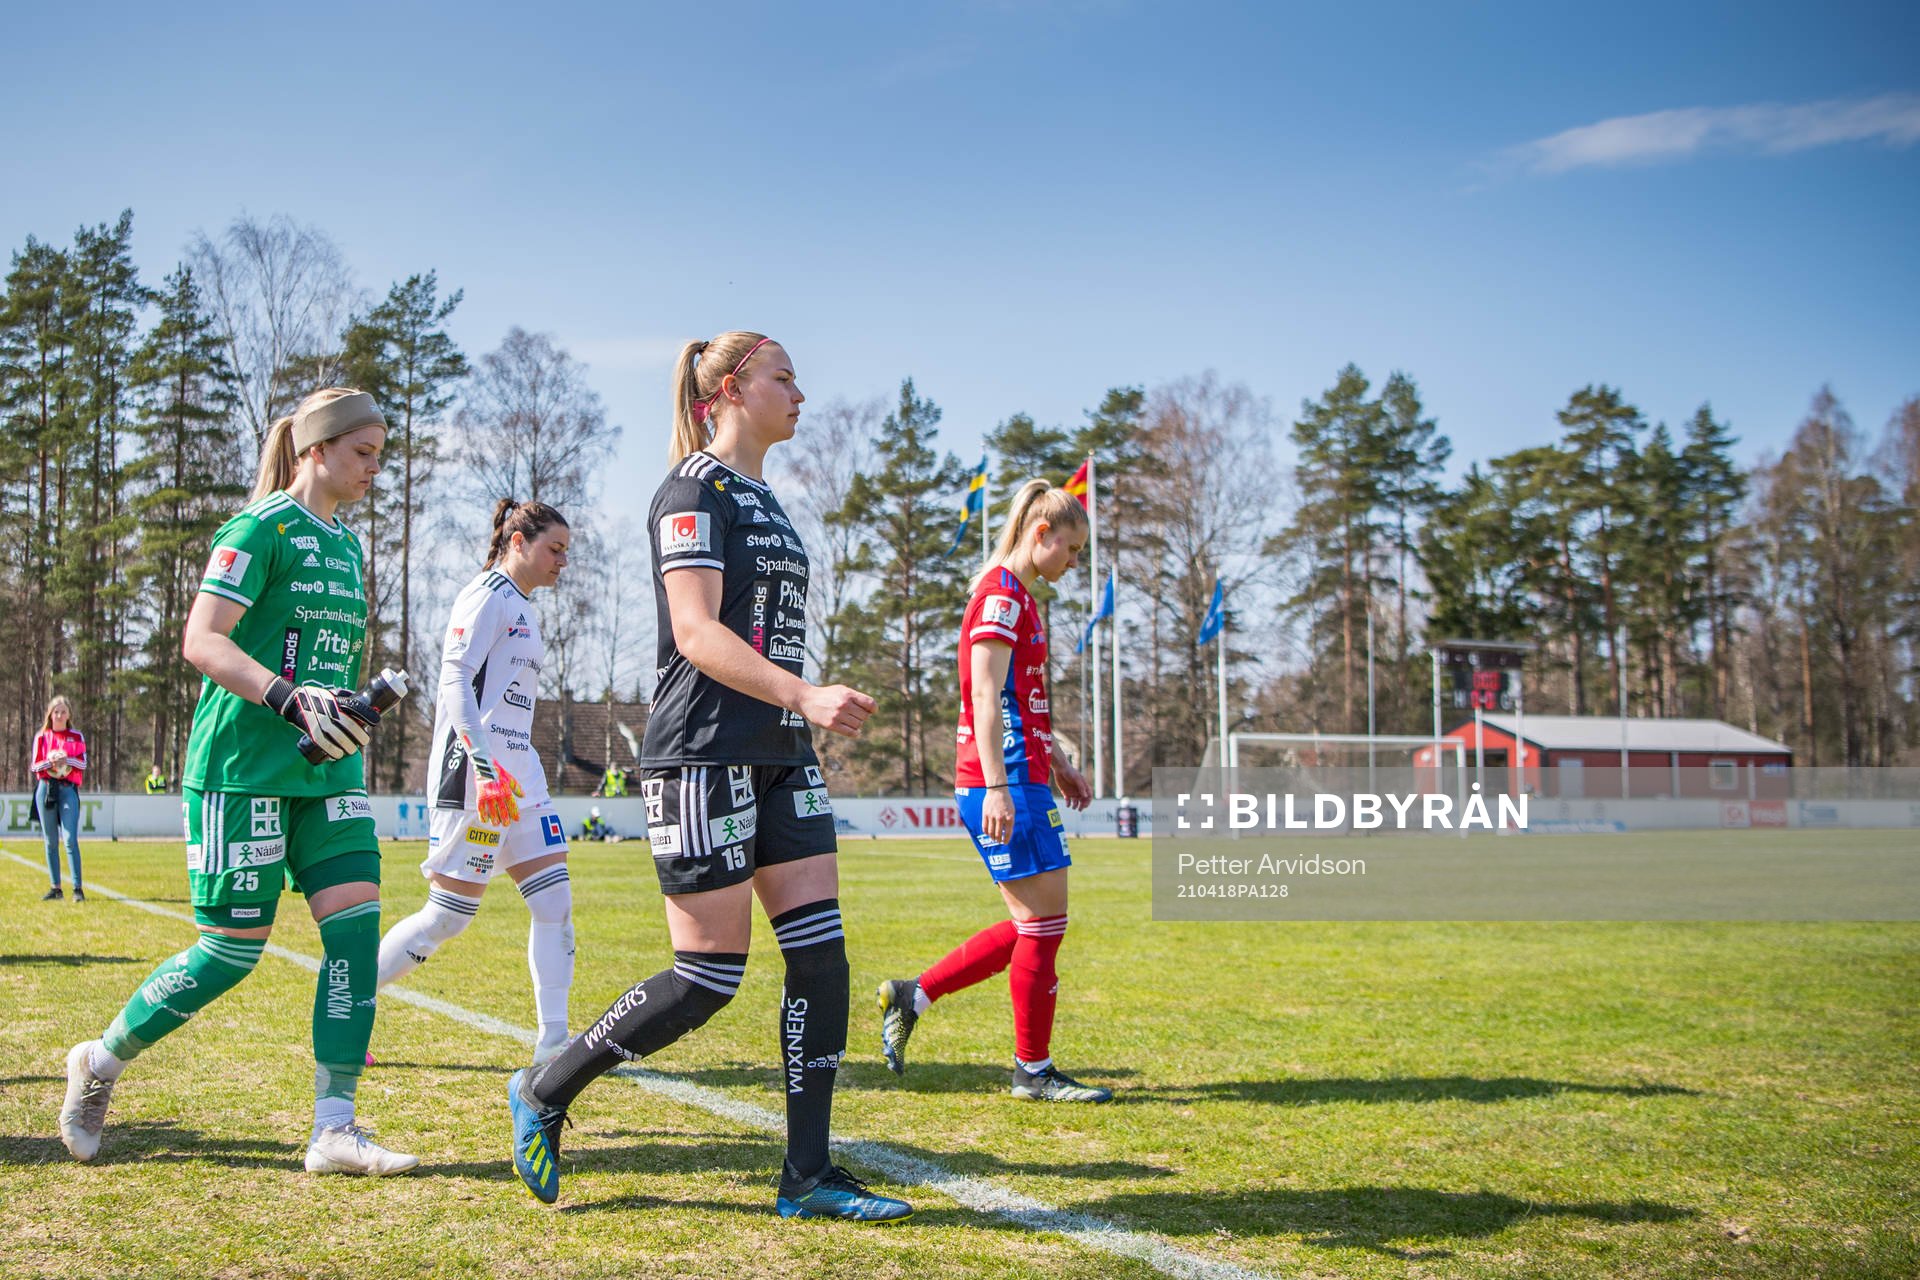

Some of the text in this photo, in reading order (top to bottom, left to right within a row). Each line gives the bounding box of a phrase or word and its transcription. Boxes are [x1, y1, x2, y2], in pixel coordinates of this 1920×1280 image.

[903, 807, 967, 828] NIB
[469, 830, 489, 843] CITY
[721, 845, 746, 871] 15
[232, 871, 259, 891] 25
[327, 958, 351, 1020] WIXNERS
[584, 982, 647, 1050] WIXNERS
[787, 997, 808, 1095] WIXNERS
